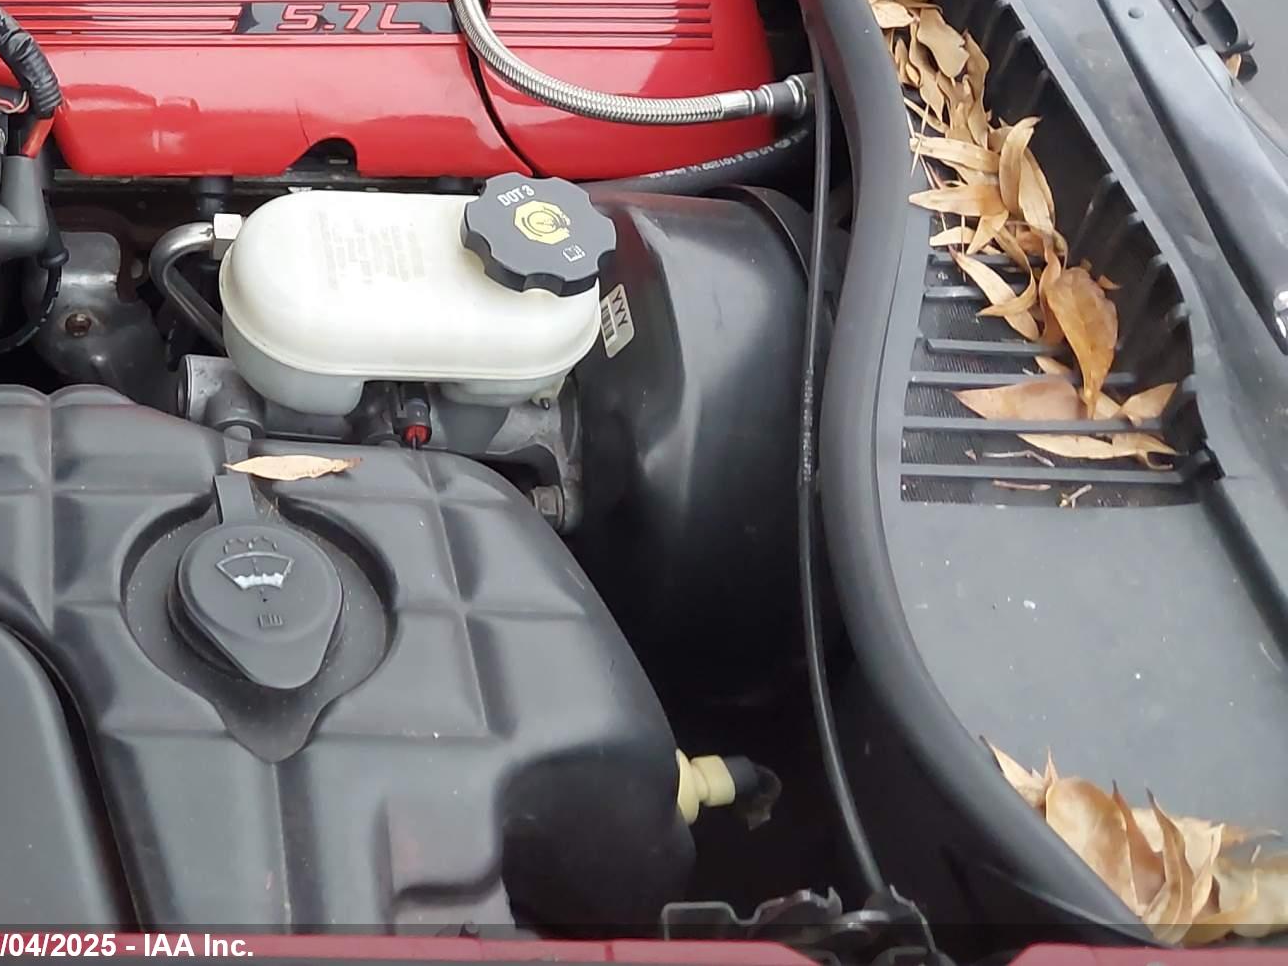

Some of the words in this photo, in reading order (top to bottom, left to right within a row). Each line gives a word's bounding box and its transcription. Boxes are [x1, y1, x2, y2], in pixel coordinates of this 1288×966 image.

[277, 3, 423, 31] 5.7L
[497, 186, 525, 207] DOT
[522, 184, 535, 197] 3
[612, 290, 628, 327] YYY
